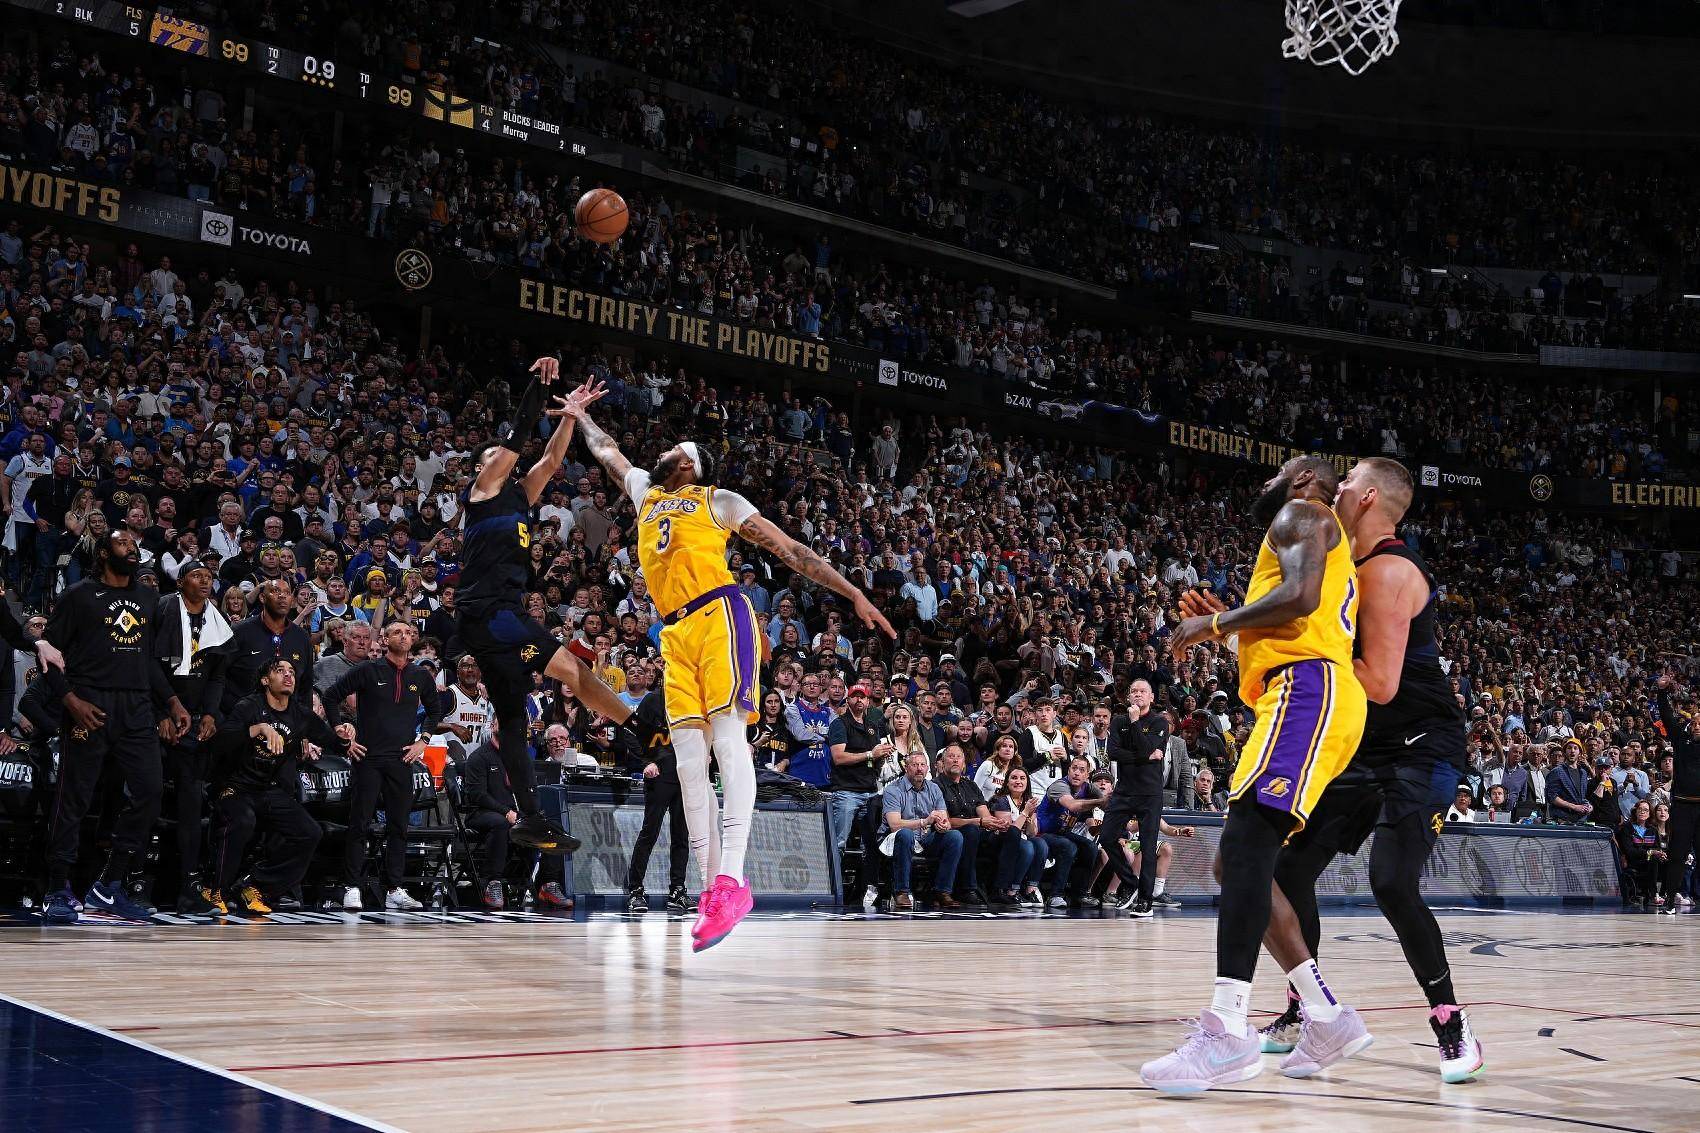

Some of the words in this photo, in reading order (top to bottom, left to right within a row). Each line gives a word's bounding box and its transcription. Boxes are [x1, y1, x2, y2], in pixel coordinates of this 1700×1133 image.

[56, 2, 63, 13] 2
[75, 7, 93, 21] BLK
[126, 6, 142, 20] FLS
[129, 22, 138, 36] 5
[222, 39, 249, 62] 99
[267, 61, 277, 74] 2
[304, 56, 335, 79] 0.9
[361, 85, 366, 98] 1
[388, 85, 413, 107] 99
[480, 104, 494, 117] FLS
[481, 120, 490, 131] 4
[503, 111, 531, 128] BLOCKS
[533, 118, 560, 135] LEADER
[502, 125, 528, 141] Murray
[559, 140, 565, 150] 2
[572, 143, 586, 156] BLK
[239, 226, 312, 255] TOYOTA
[519, 278, 659, 336] ELECTRIFY
[667, 311, 710, 348] THE
[717, 323, 831, 372] PLAYOFFS
[902, 370, 947, 390] TOYOTA
[1004, 392, 1032, 410] bZ4X
[1169, 420, 1254, 461] ELECTRIFY
[1259, 441, 1286, 467] THE
[1441, 473, 1482, 488] TOYOTA
[656, 517, 671, 554] 3
[110, 631, 142, 644] PLAYOFFS
[460, 712, 488, 724] NUGGET
